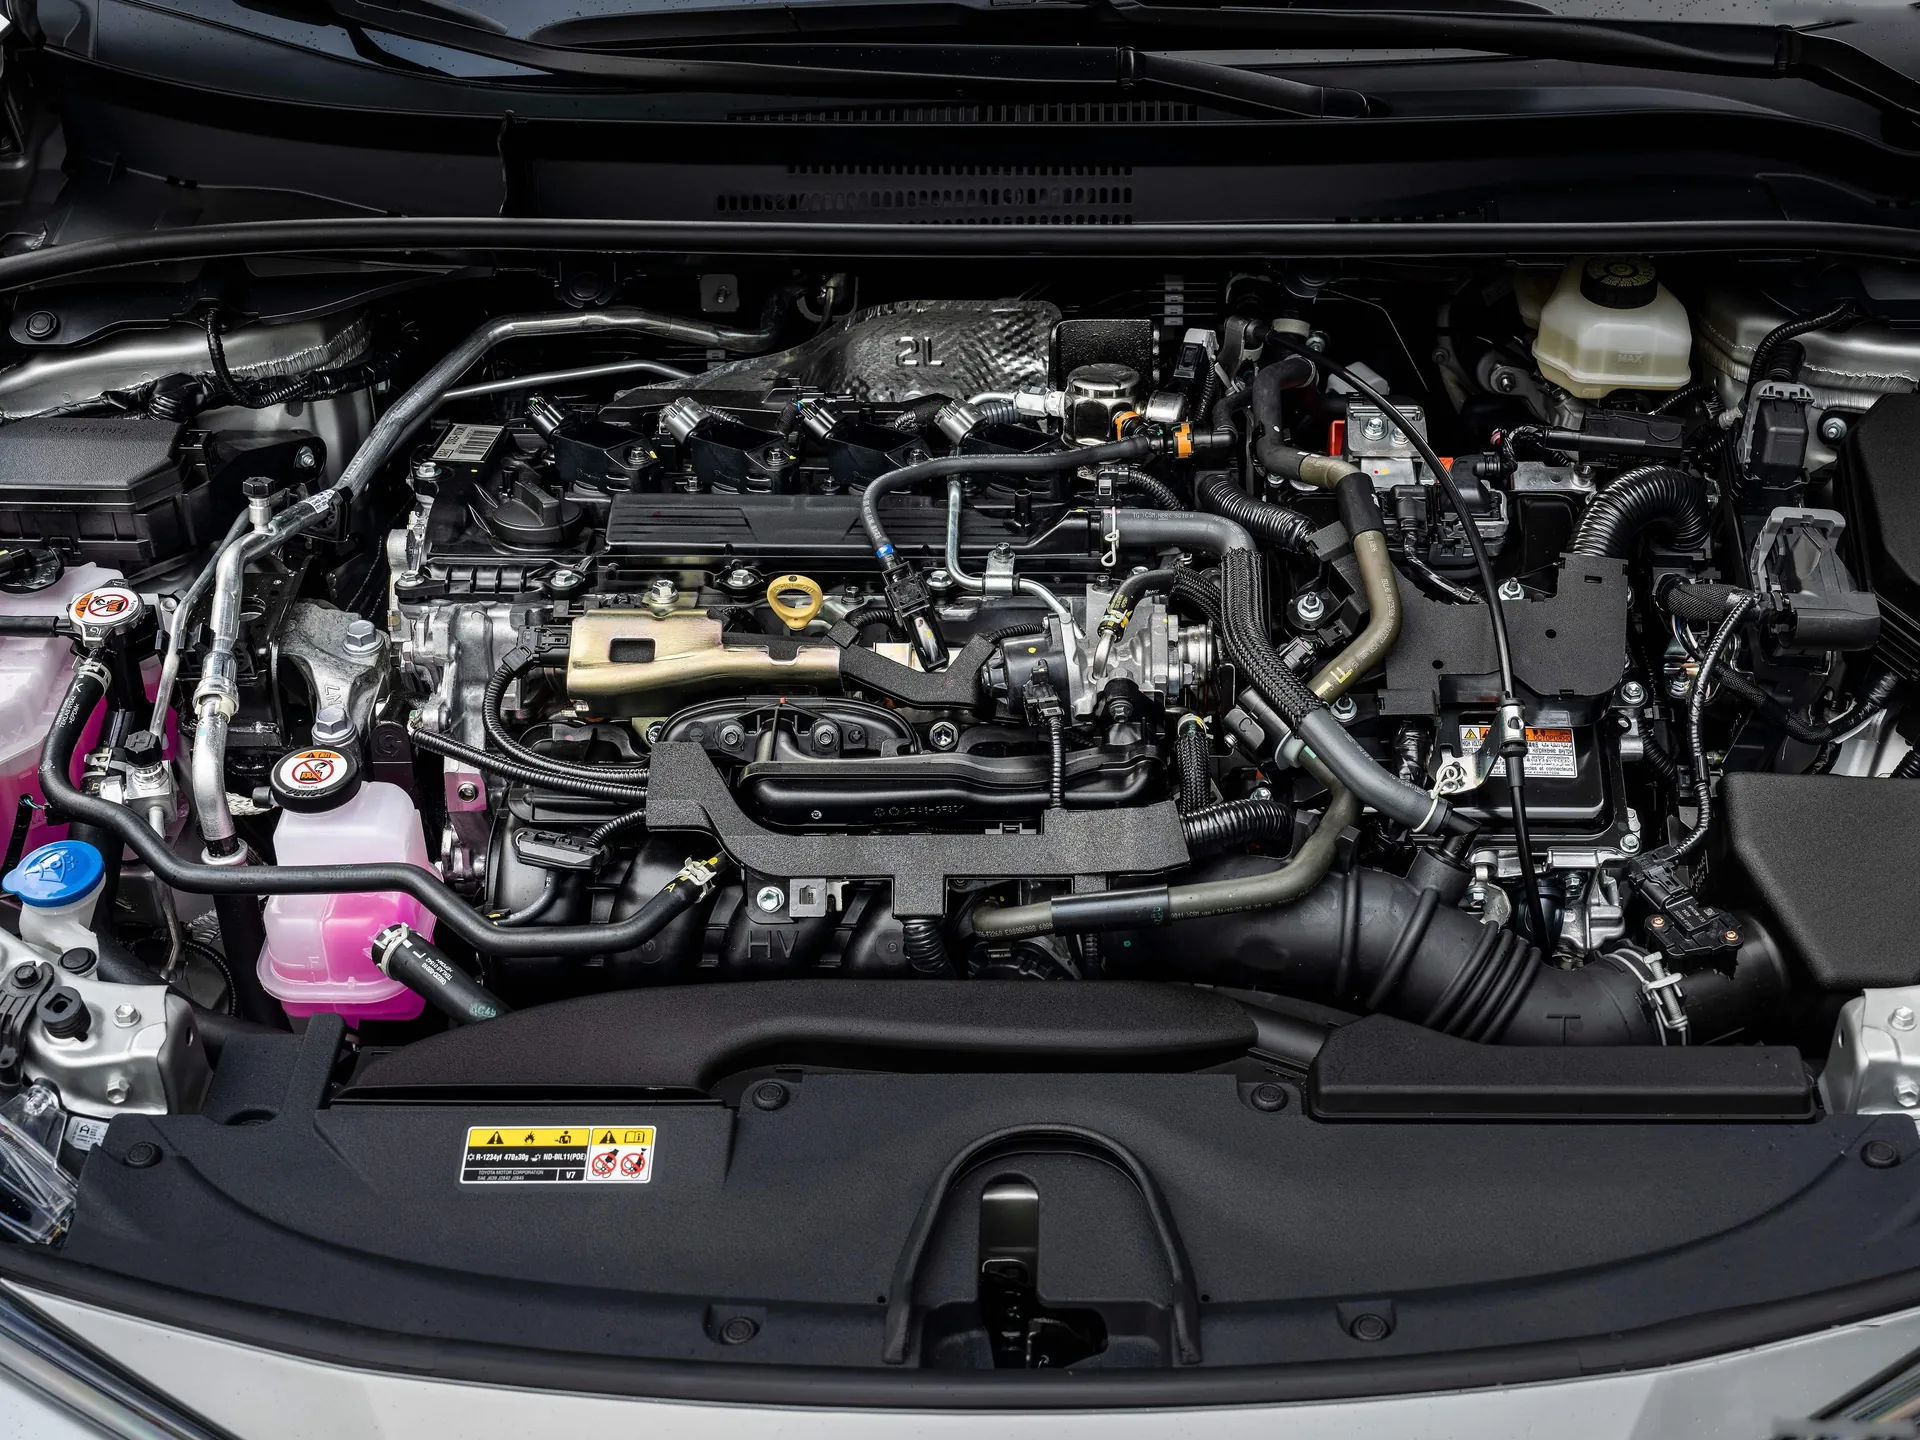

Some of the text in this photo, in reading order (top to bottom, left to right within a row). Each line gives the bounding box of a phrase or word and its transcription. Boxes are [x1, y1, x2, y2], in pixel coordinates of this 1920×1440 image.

[895, 335, 945, 367] 2L
[1617, 353, 1643, 364] MAX
[71, 683, 84, 693] K
[664, 882, 676, 893] A
[745, 929, 800, 960] HV
[307, 956, 320, 969] F
[475, 1153, 502, 1162] R-1234yf
[503, 1153, 529, 1162] 470±30g
[566, 1171, 576, 1179] V7
